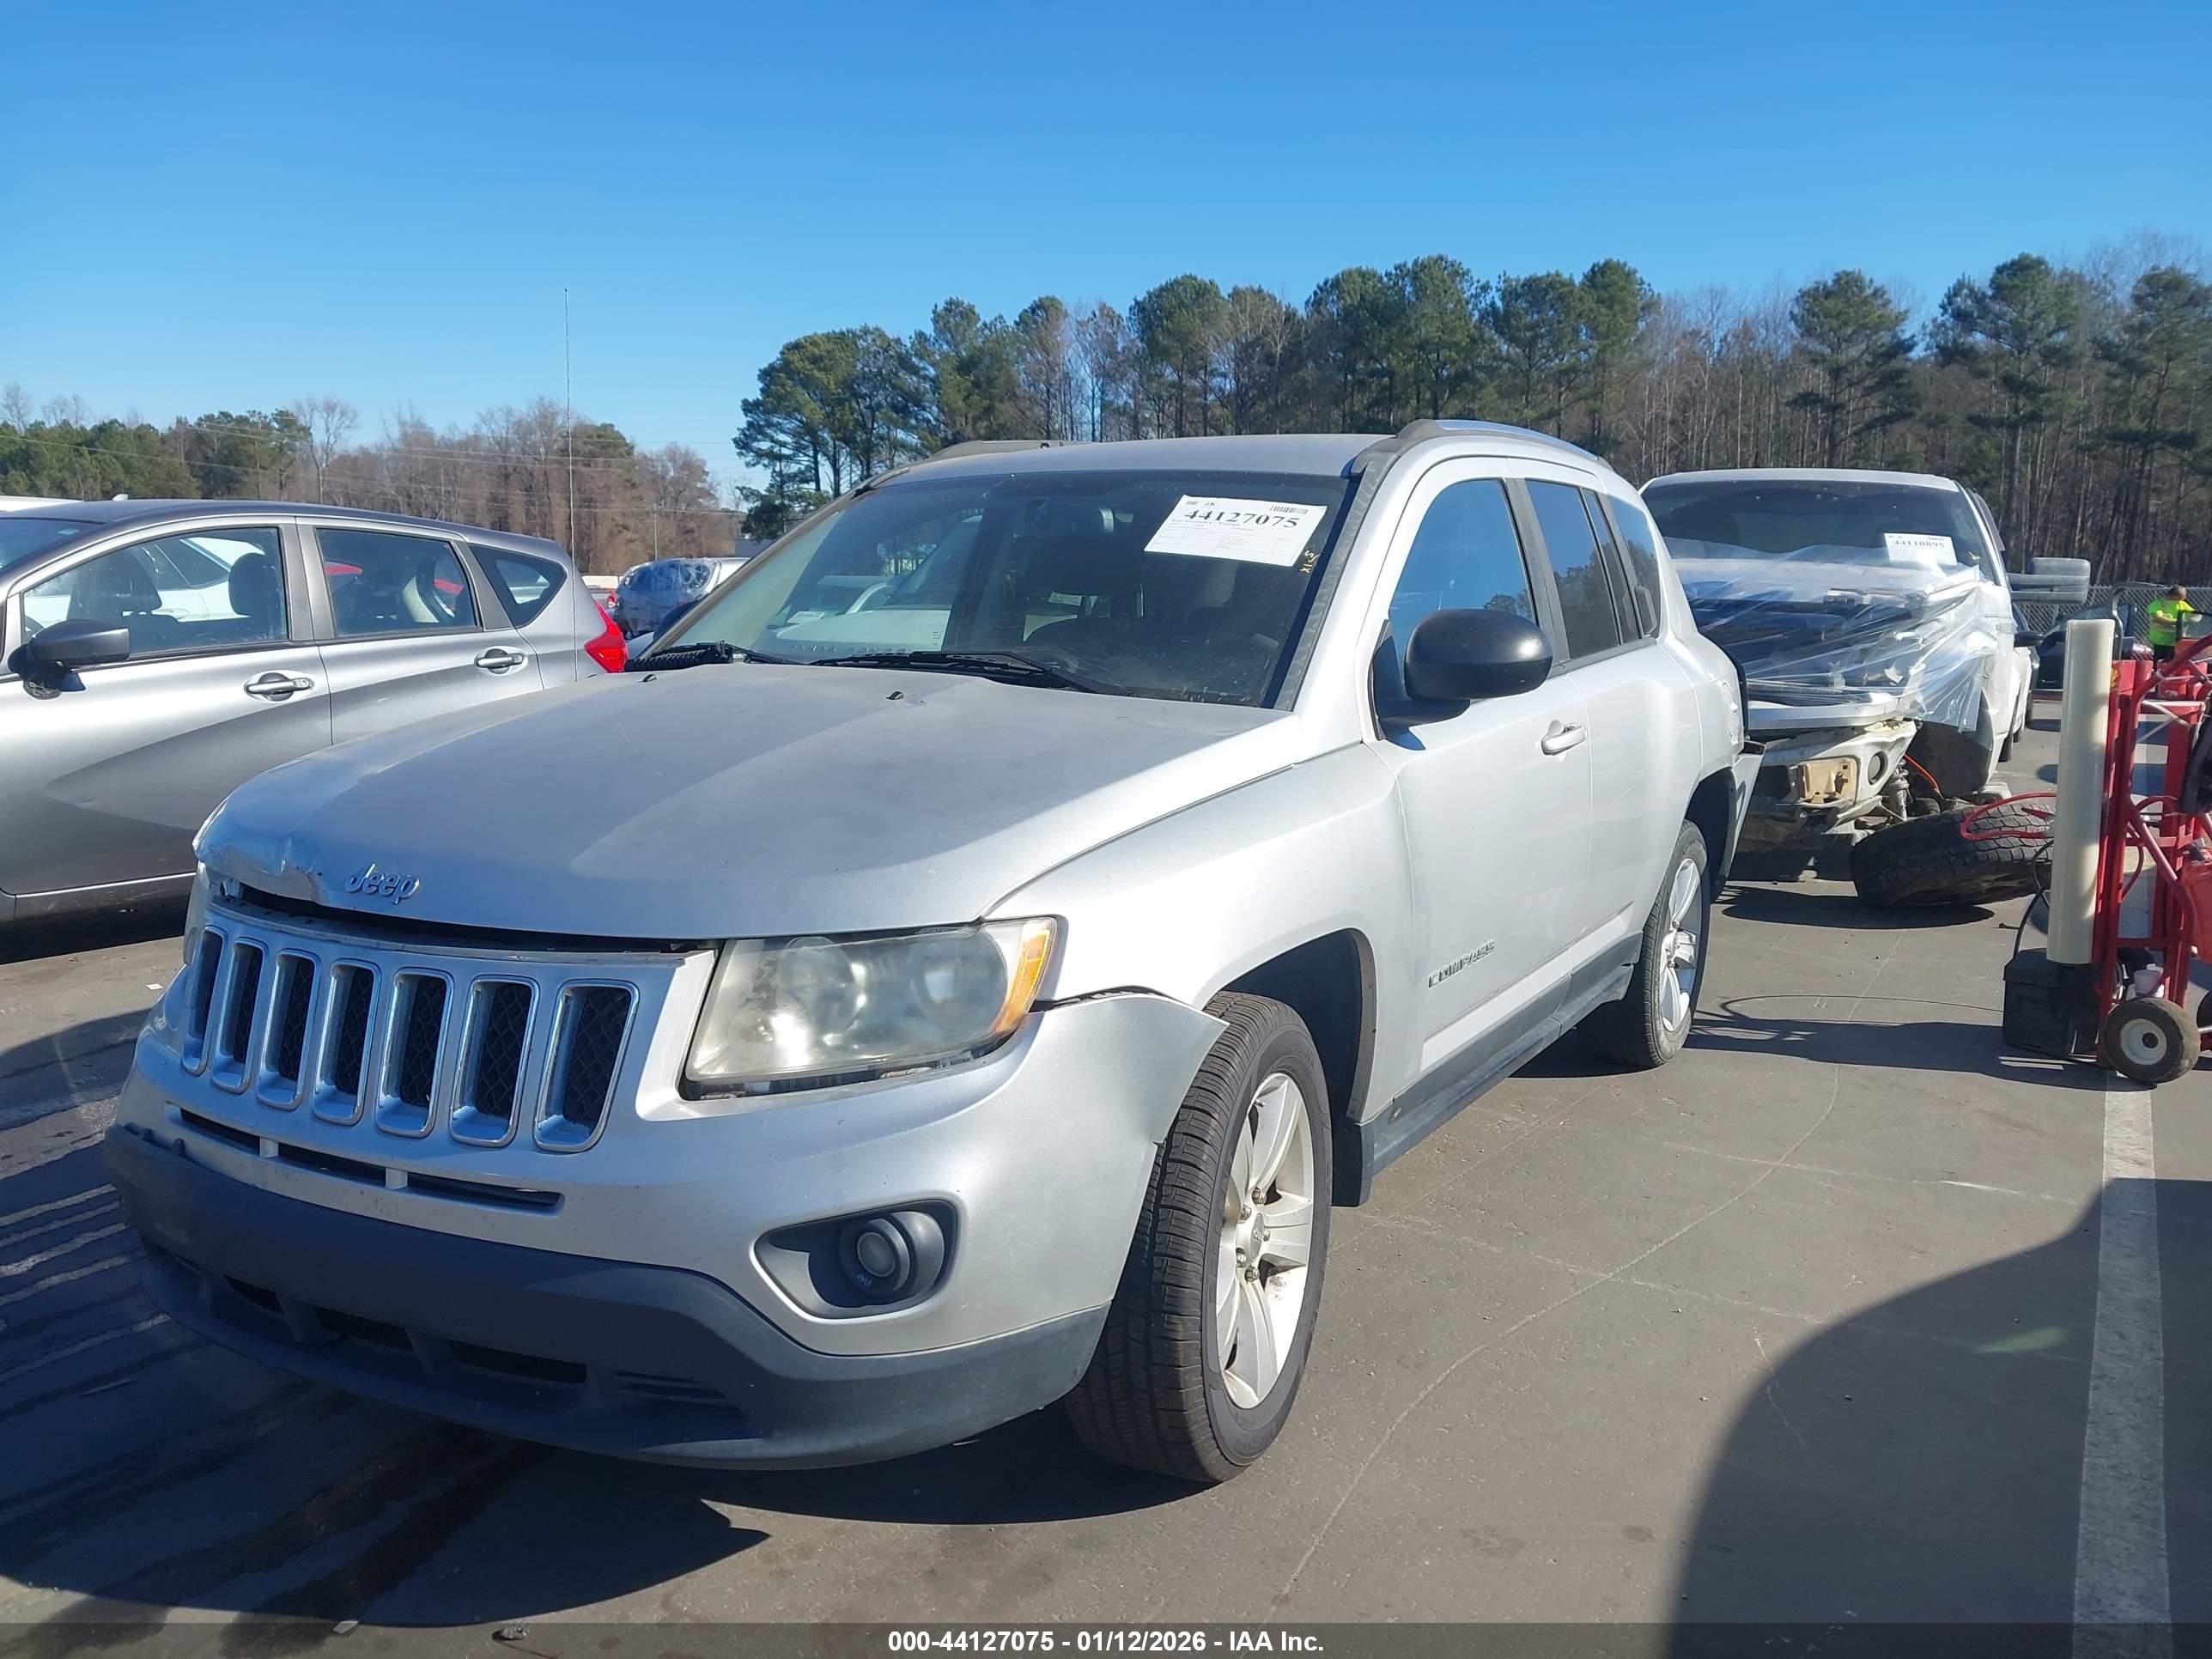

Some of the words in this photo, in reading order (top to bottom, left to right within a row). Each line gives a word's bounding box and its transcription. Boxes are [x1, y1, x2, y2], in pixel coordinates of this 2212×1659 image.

[1184, 509, 1300, 529] 44127075
[345, 863, 421, 905] Jeep
[1427, 939, 1496, 988] COMPASS
